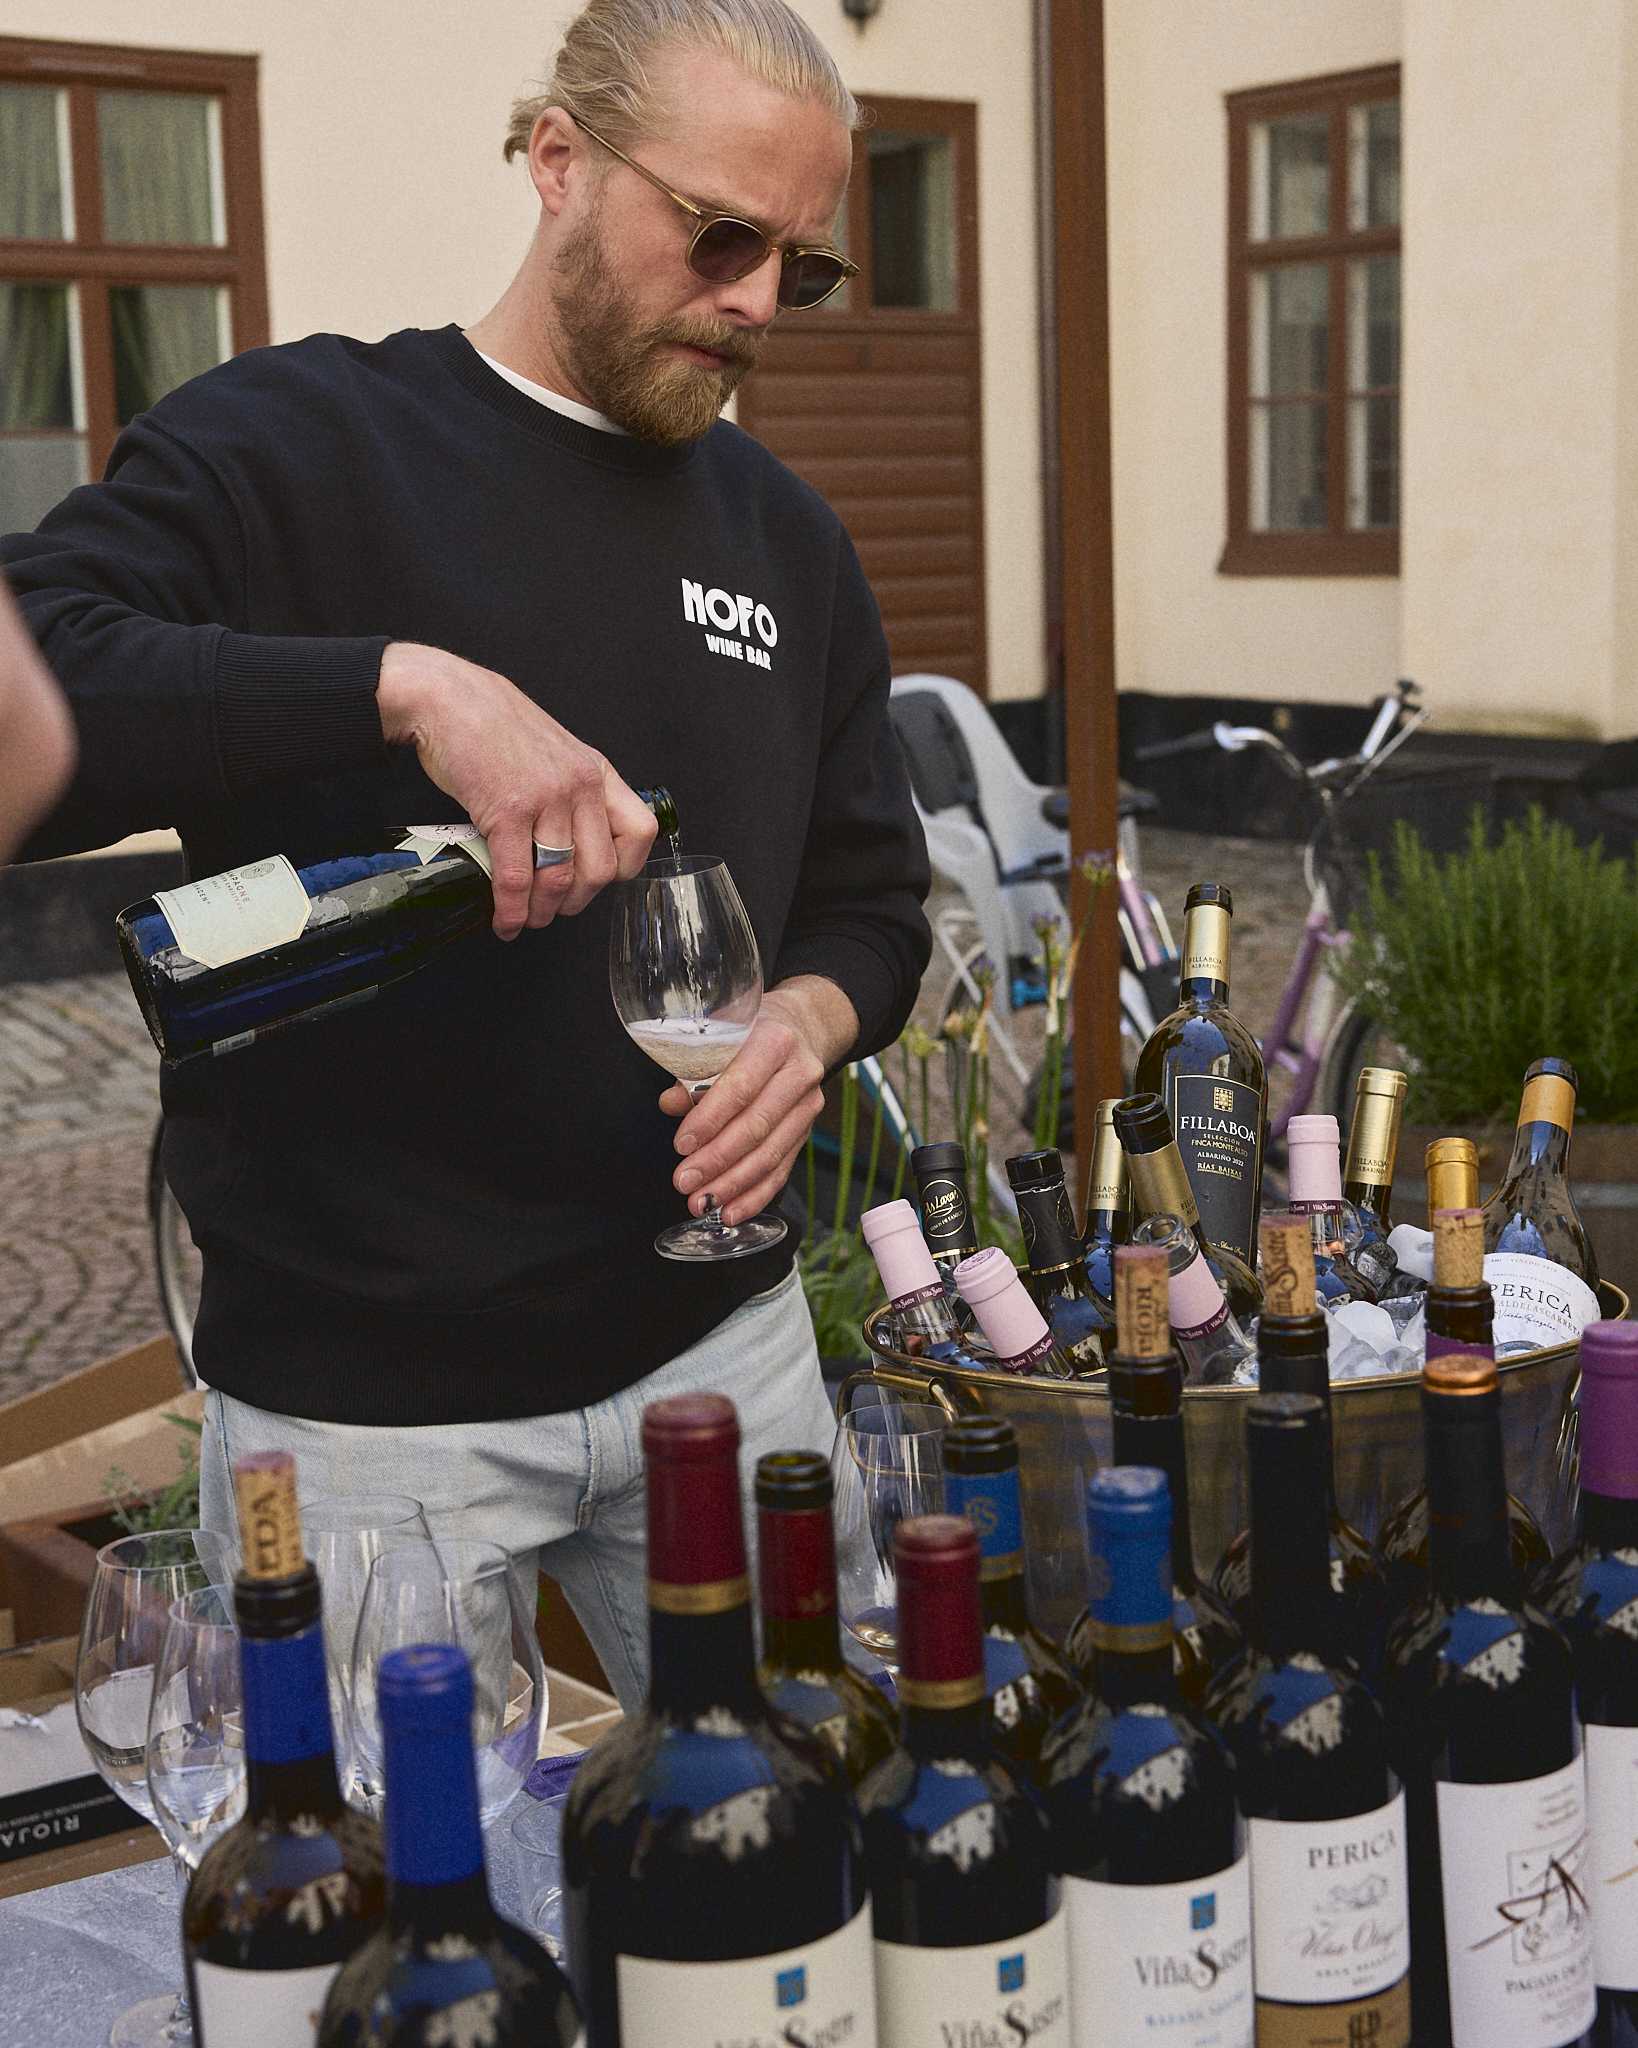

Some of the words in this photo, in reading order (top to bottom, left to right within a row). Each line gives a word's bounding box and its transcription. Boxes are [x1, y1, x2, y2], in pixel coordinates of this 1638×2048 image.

[681, 577, 778, 648] NOFO
[705, 633, 744, 660] WINE
[745, 645, 772, 670] BAR
[1188, 956, 1223, 966] FILLABOA
[1180, 1115, 1257, 1145] FILLABOA
[1191, 1139, 1212, 1148] FINCA
[1212, 1141, 1235, 1153] MONTE
[1197, 1151, 1232, 1163] ALBARIÑO
[1197, 1161, 1216, 1170] RÍAS
[1218, 1165, 1243, 1178] BAIXAS
[1489, 1283, 1573, 1320] PERICA
[0, 1814, 80, 1849] RIOJA
